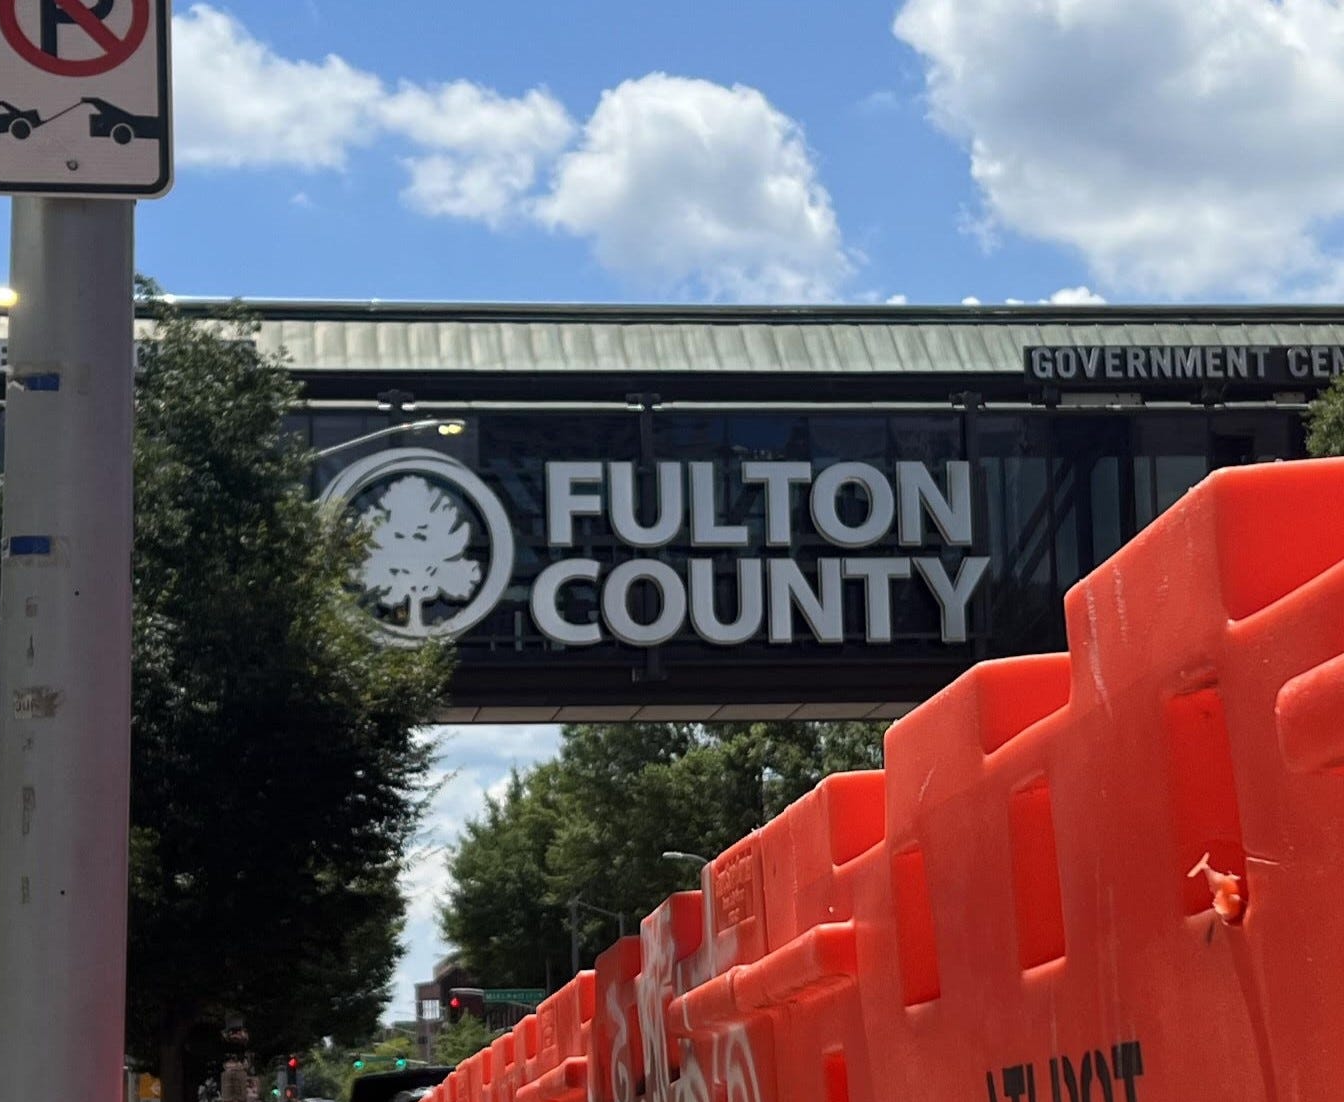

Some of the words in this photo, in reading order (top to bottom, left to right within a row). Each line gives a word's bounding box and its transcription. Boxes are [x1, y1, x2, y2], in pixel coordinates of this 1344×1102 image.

[1031, 346, 1270, 379] GOVERNMENT
[545, 460, 972, 547] FULTON
[530, 557, 991, 645] COUNTY
